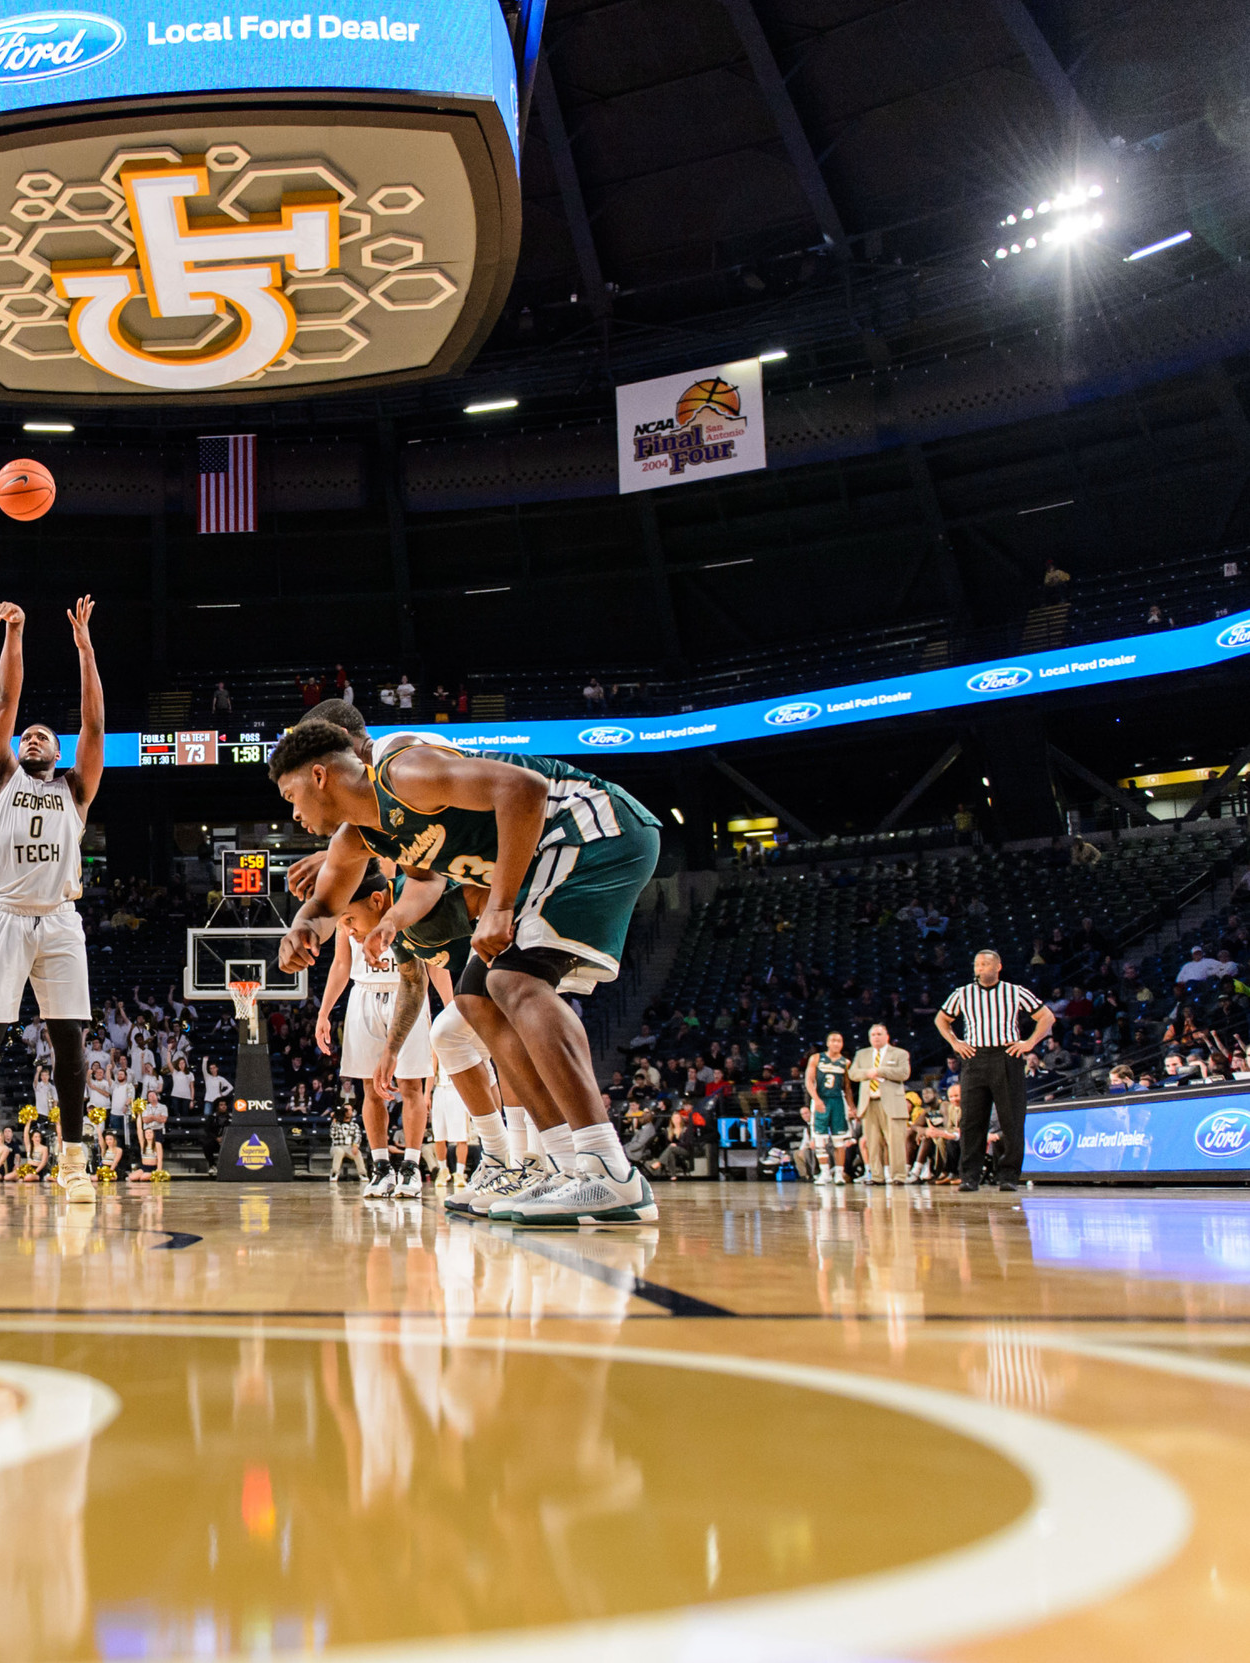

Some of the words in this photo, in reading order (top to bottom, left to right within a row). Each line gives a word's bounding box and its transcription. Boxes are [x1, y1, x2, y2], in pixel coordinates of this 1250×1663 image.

[148, 17, 233, 46] Local
[239, 15, 310, 41] Ford
[317, 15, 420, 43] Dealer
[634, 418, 674, 436] NCAA
[706, 425, 724, 433] San
[706, 429, 745, 442] Antonio
[634, 424, 703, 461] Final
[642, 459, 669, 472] 2004
[670, 441, 734, 475] Four
[1039, 664, 1070, 678] Local
[1071, 659, 1098, 672] Ford
[1099, 653, 1137, 669] Dealer
[979, 671, 1019, 689] Ford
[827, 699, 854, 713] Local
[855, 695, 878, 707] Ford
[878, 691, 912, 704] Dealer
[775, 706, 810, 723] Ford
[142, 734, 165, 743] FOULS
[180, 734, 191, 743] GA
[191, 733, 210, 742] TECH
[240, 733, 260, 742] POSS
[452, 736, 477, 745] Local
[478, 736, 499, 744] Ford
[500, 735, 531, 744] Dealer
[588, 730, 623, 745] Ford
[640, 730, 665, 741] Local
[665, 727, 688, 738] Ford
[688, 723, 717, 737] Dealer
[185, 744, 205, 763] 73
[232, 746, 260, 763] 1:58
[12, 791, 64, 811] GEORGIA
[30, 816, 43, 838] 0
[14, 844, 59, 863] TECH
[240, 855, 265, 869] 1:58
[233, 868, 261, 893] 30
[824, 1073, 835, 1088] 3
[247, 1100, 273, 1111] PNC
[1038, 1128, 1067, 1155] Ford
[1077, 1133, 1099, 1148] Local
[1099, 1132, 1116, 1147] Ford
[1117, 1130, 1146, 1146] Dealer
[1204, 1116, 1247, 1149] Ford
